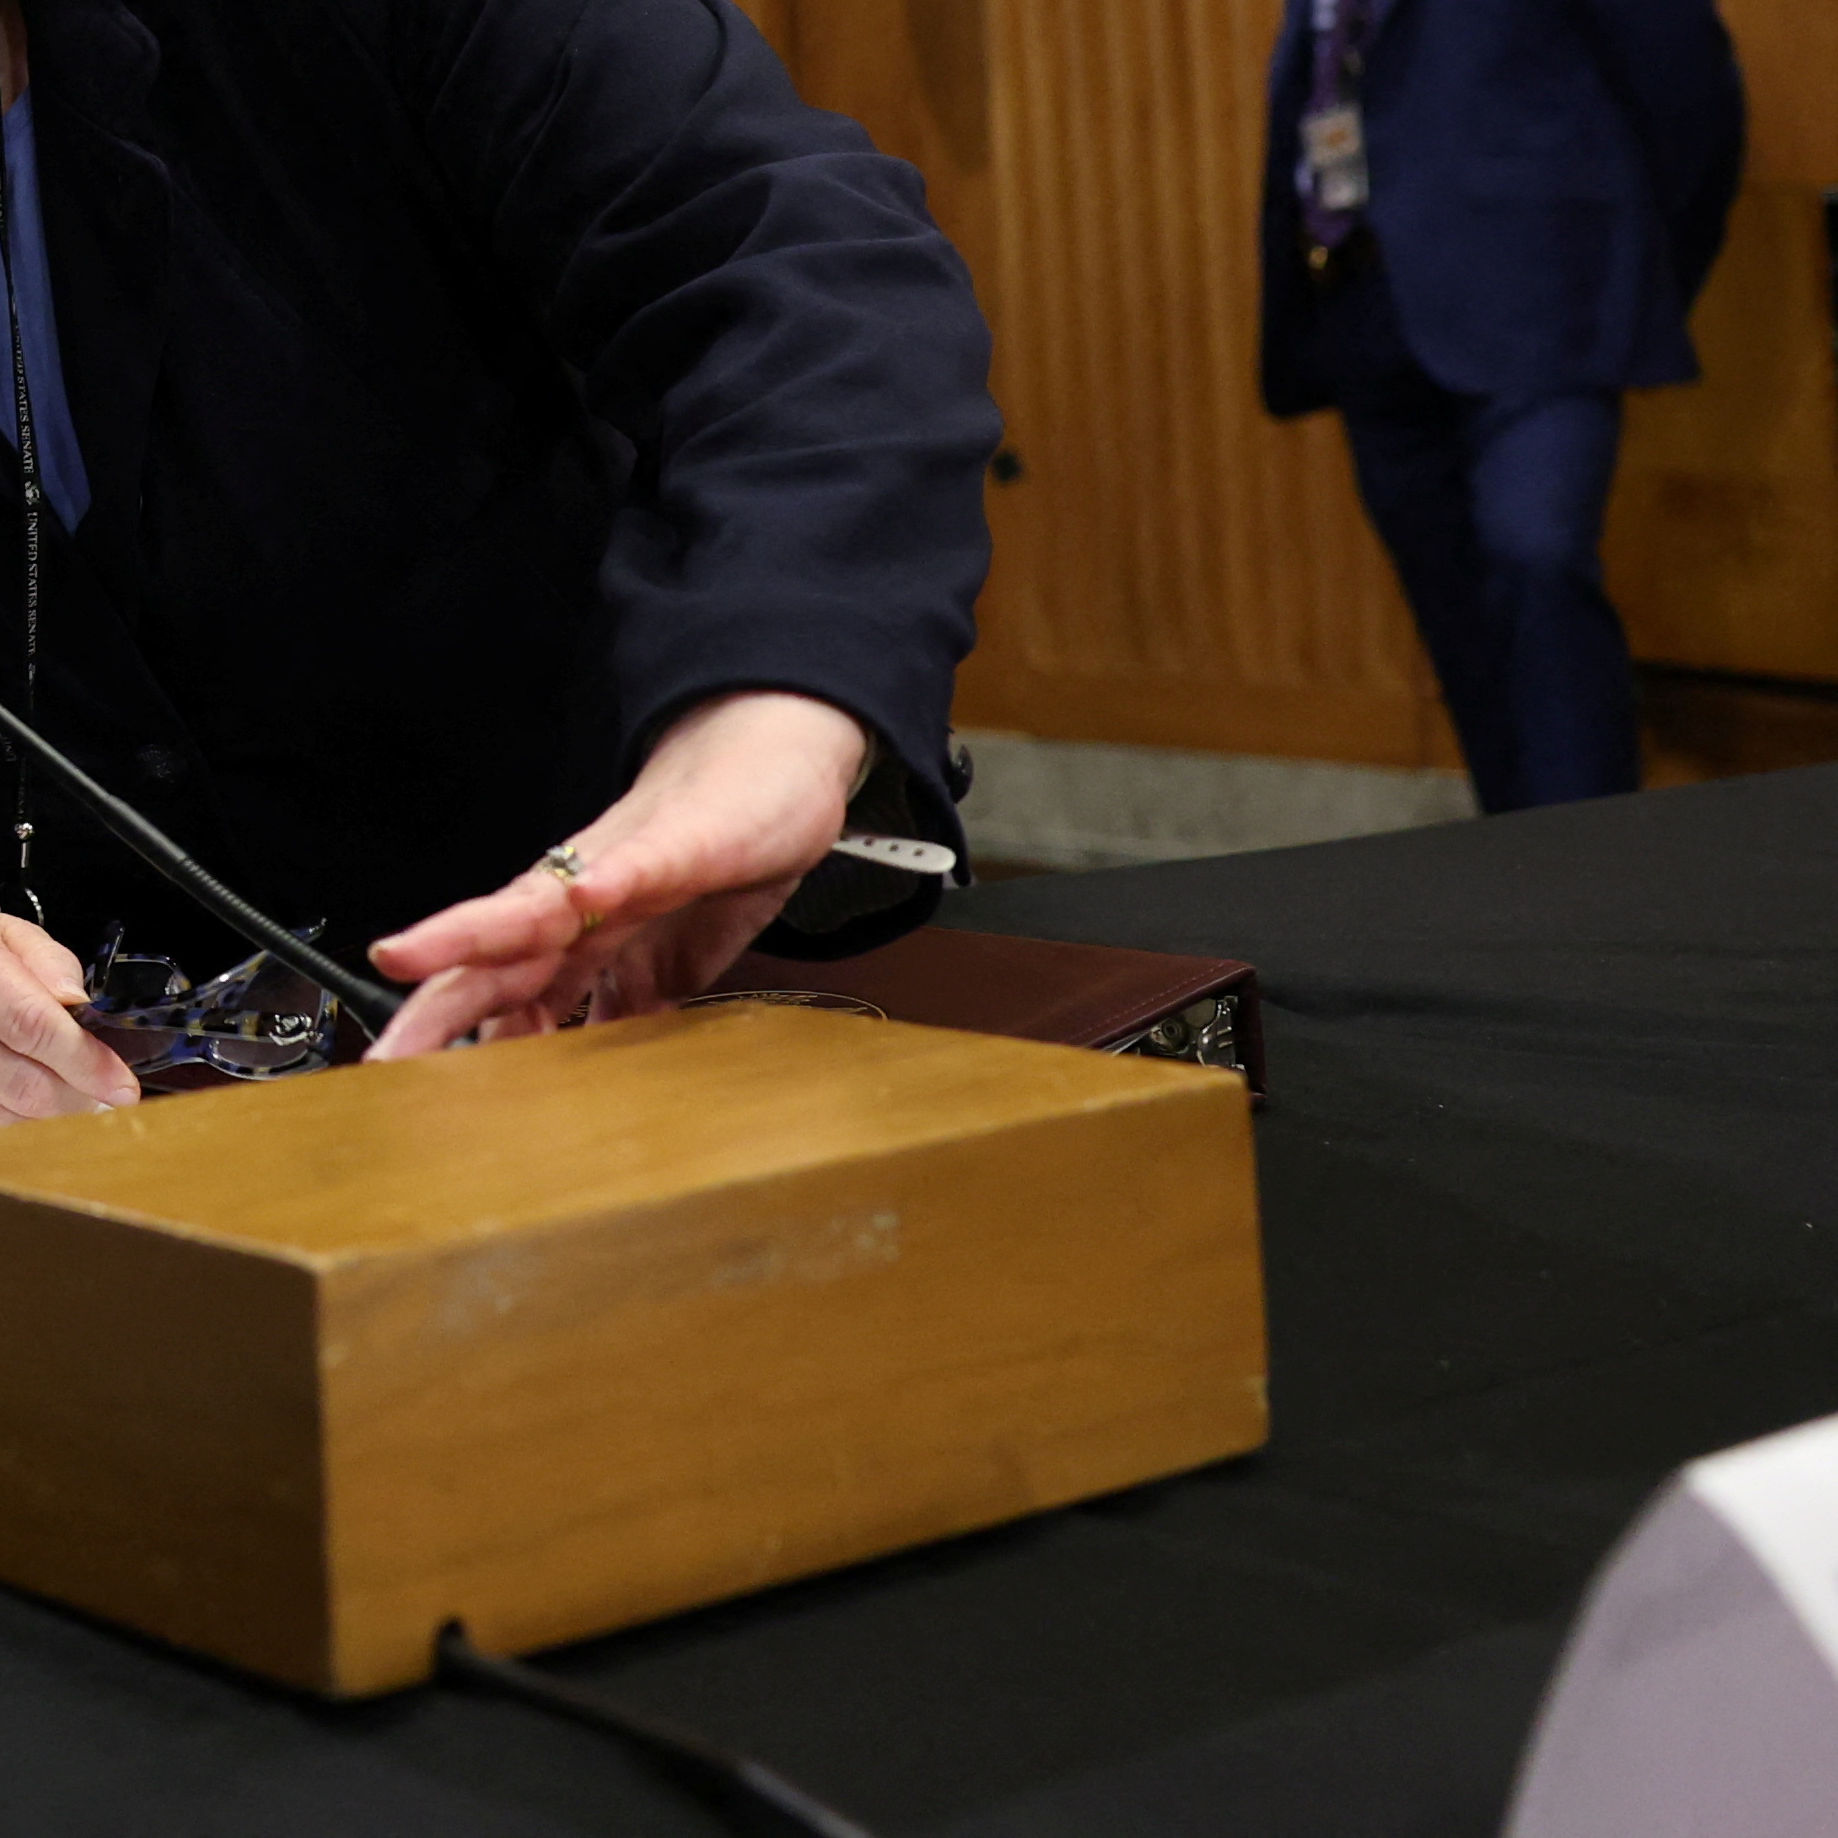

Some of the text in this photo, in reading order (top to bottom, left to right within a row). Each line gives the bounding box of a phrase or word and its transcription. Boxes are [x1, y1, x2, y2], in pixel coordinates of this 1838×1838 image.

[16, 375, 30, 423] STATES
[20, 425, 35, 475] SENATE
[26, 509, 39, 562] UNITED
[26, 562, 39, 610] STATES
